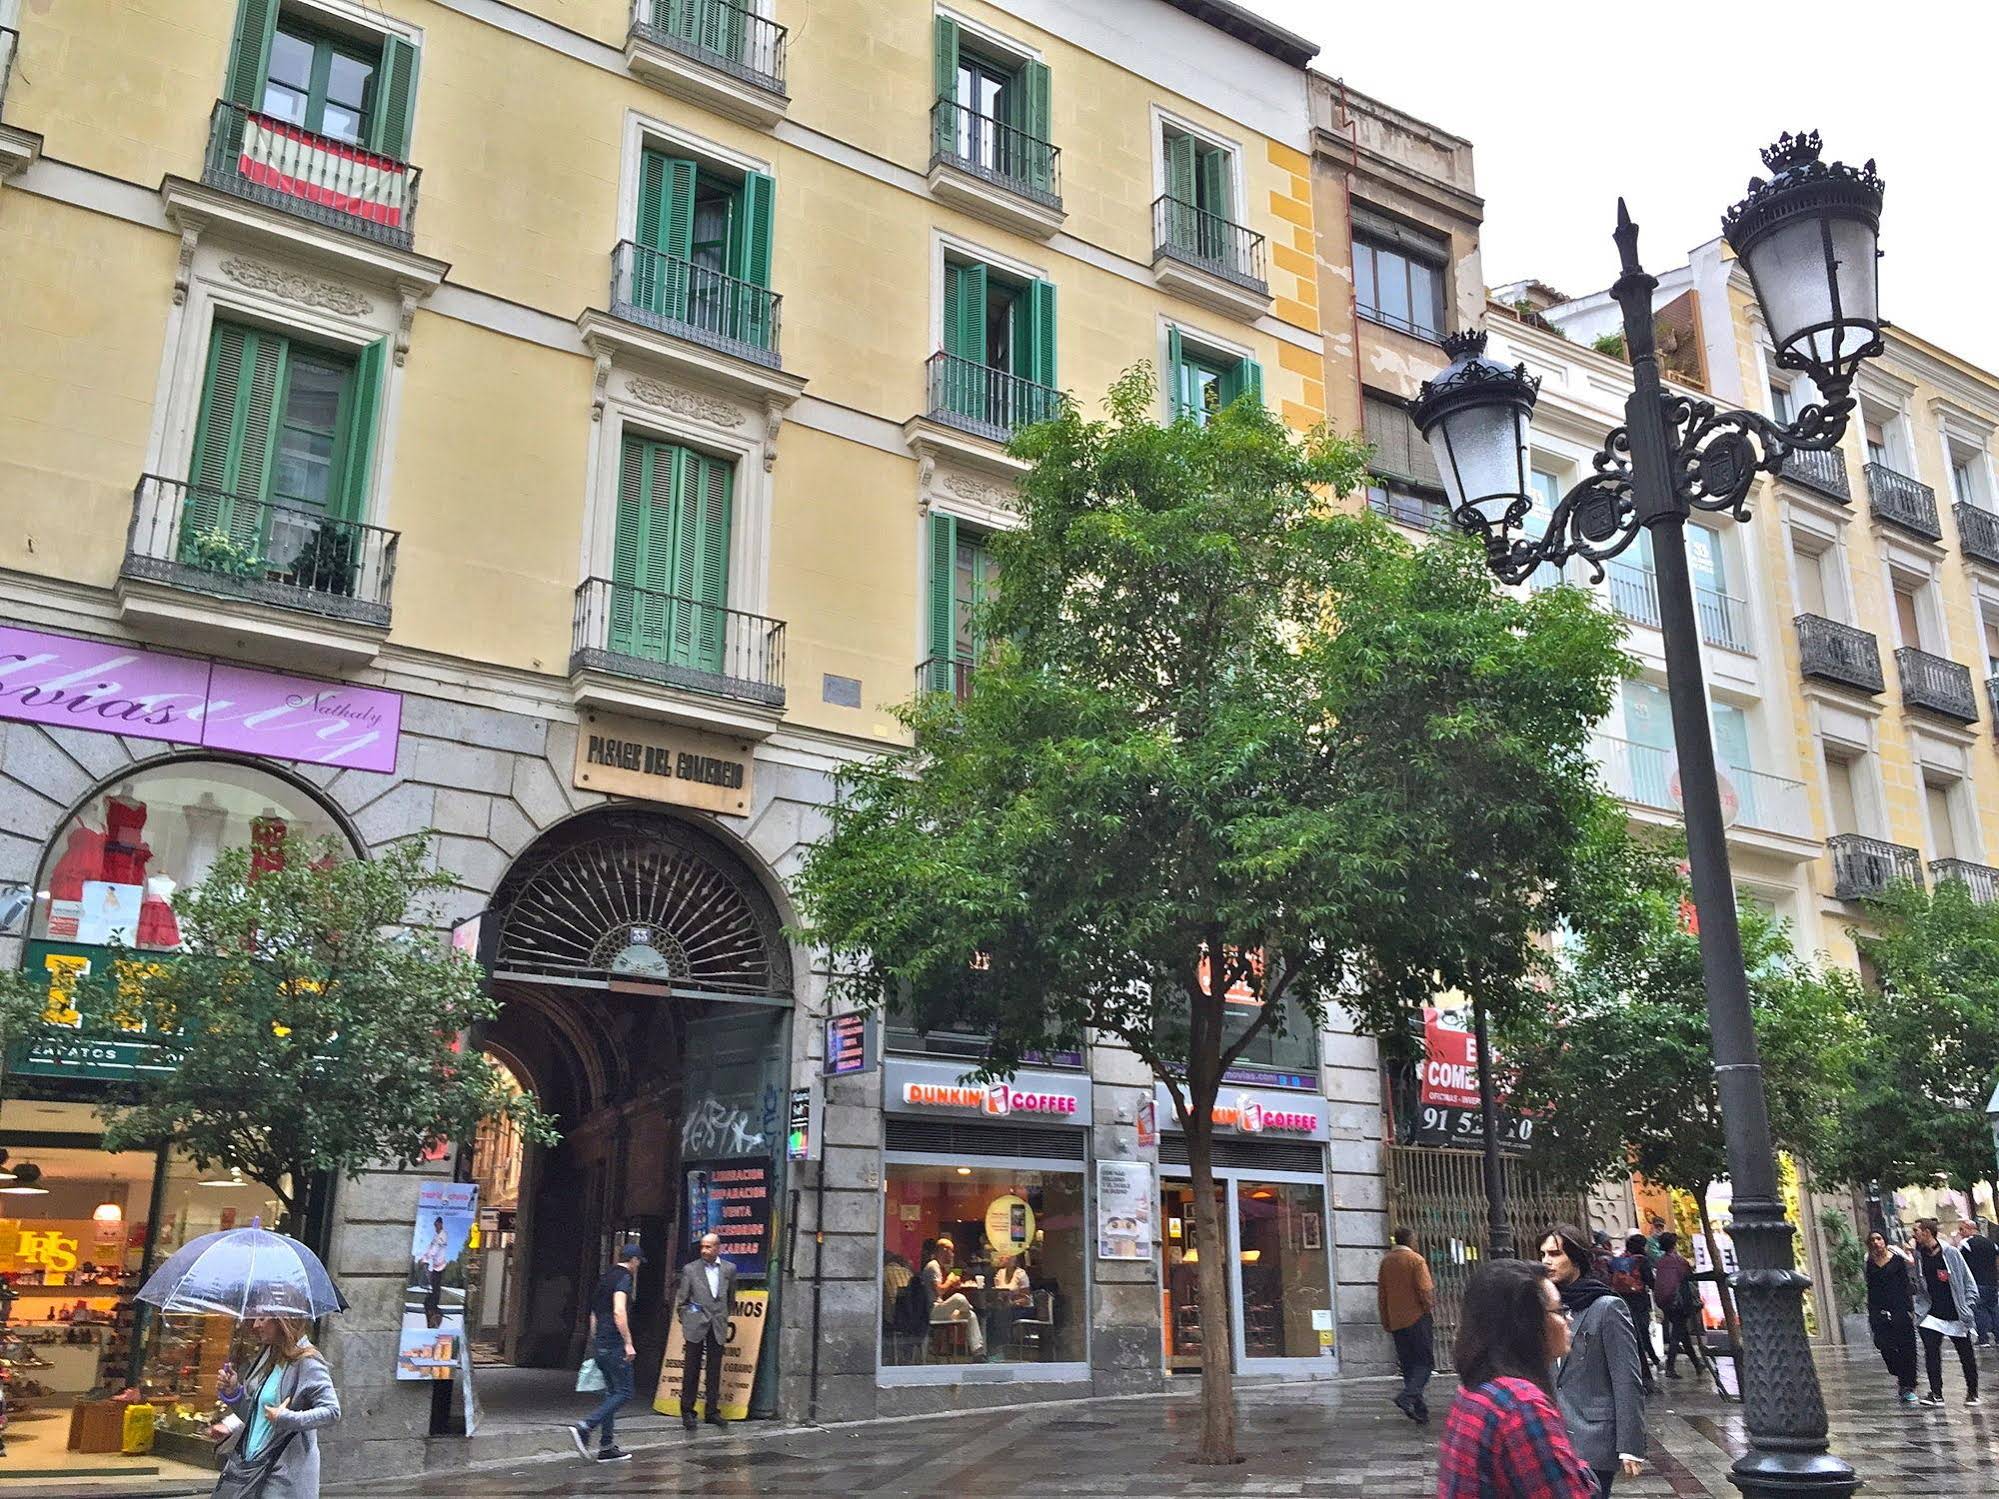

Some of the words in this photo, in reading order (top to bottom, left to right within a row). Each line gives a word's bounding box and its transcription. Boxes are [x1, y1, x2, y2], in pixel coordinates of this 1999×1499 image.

[286, 691, 383, 728] Nathaly
[644, 745, 672, 777] DEL
[676, 752, 744, 790] COMERCIO
[909, 1084, 985, 1106] DUNKIN'
[1012, 1093, 1077, 1114] COFFEE
[1263, 1111, 1318, 1131] COFFEE
[1422, 1107, 1449, 1132] 91
